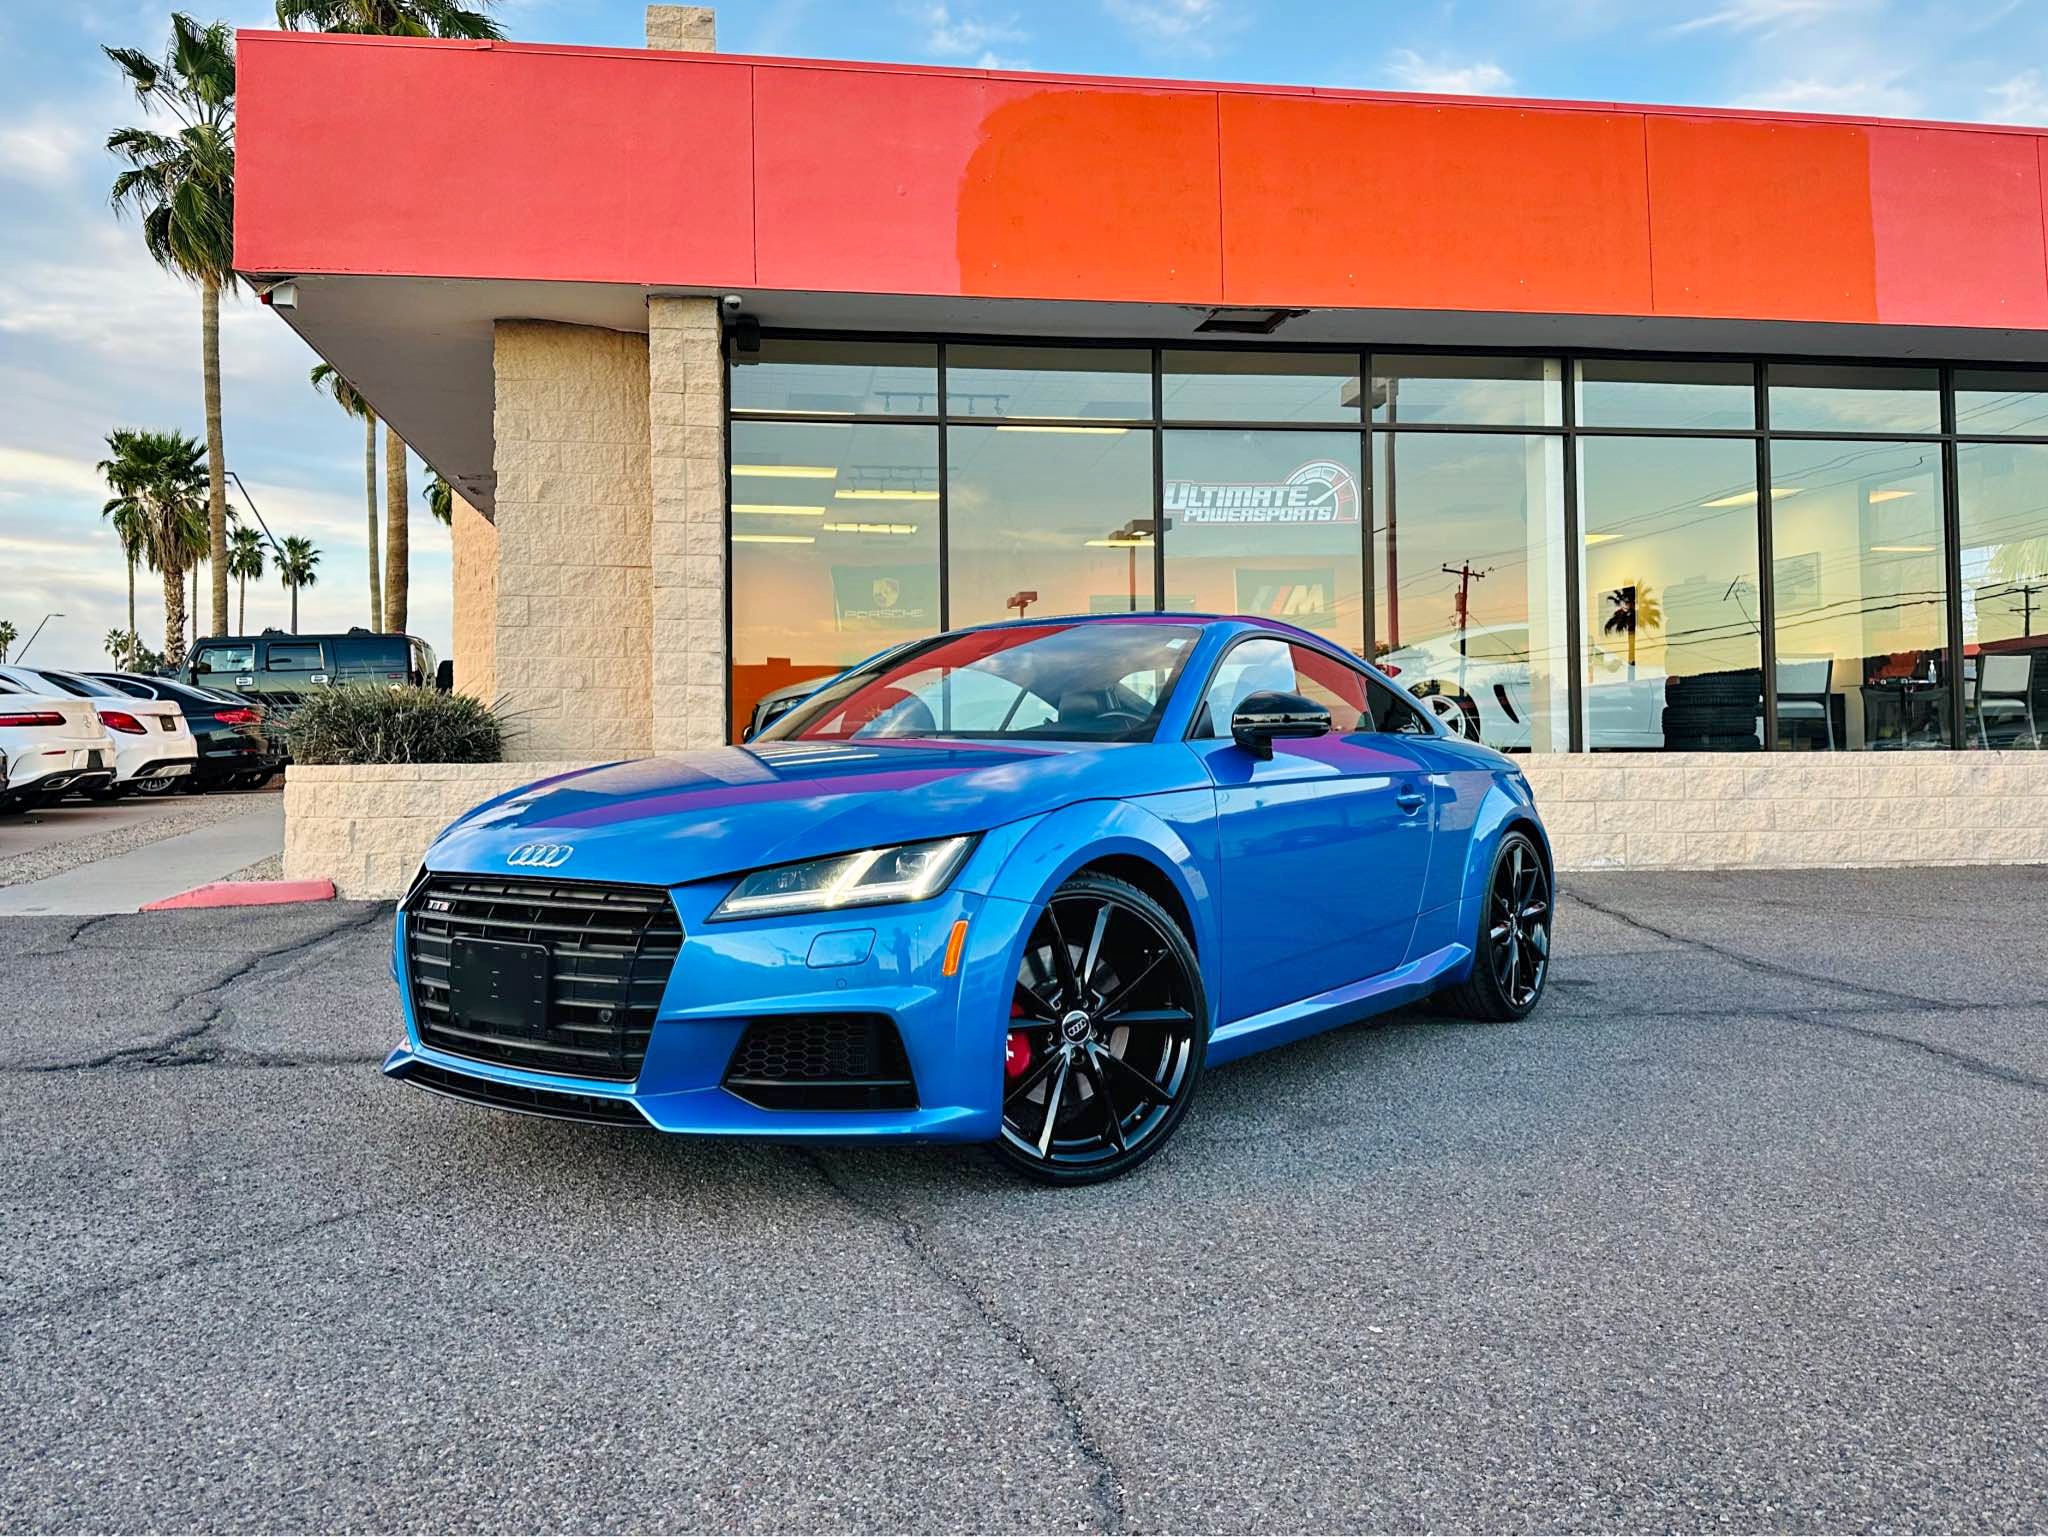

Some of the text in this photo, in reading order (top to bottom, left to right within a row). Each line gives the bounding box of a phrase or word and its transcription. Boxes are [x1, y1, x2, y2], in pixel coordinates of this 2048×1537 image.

[1163, 483, 1309, 510] ULTIMATE
[1184, 506, 1333, 522] POWERSPORTS
[844, 609, 924, 618] PORSCHE
